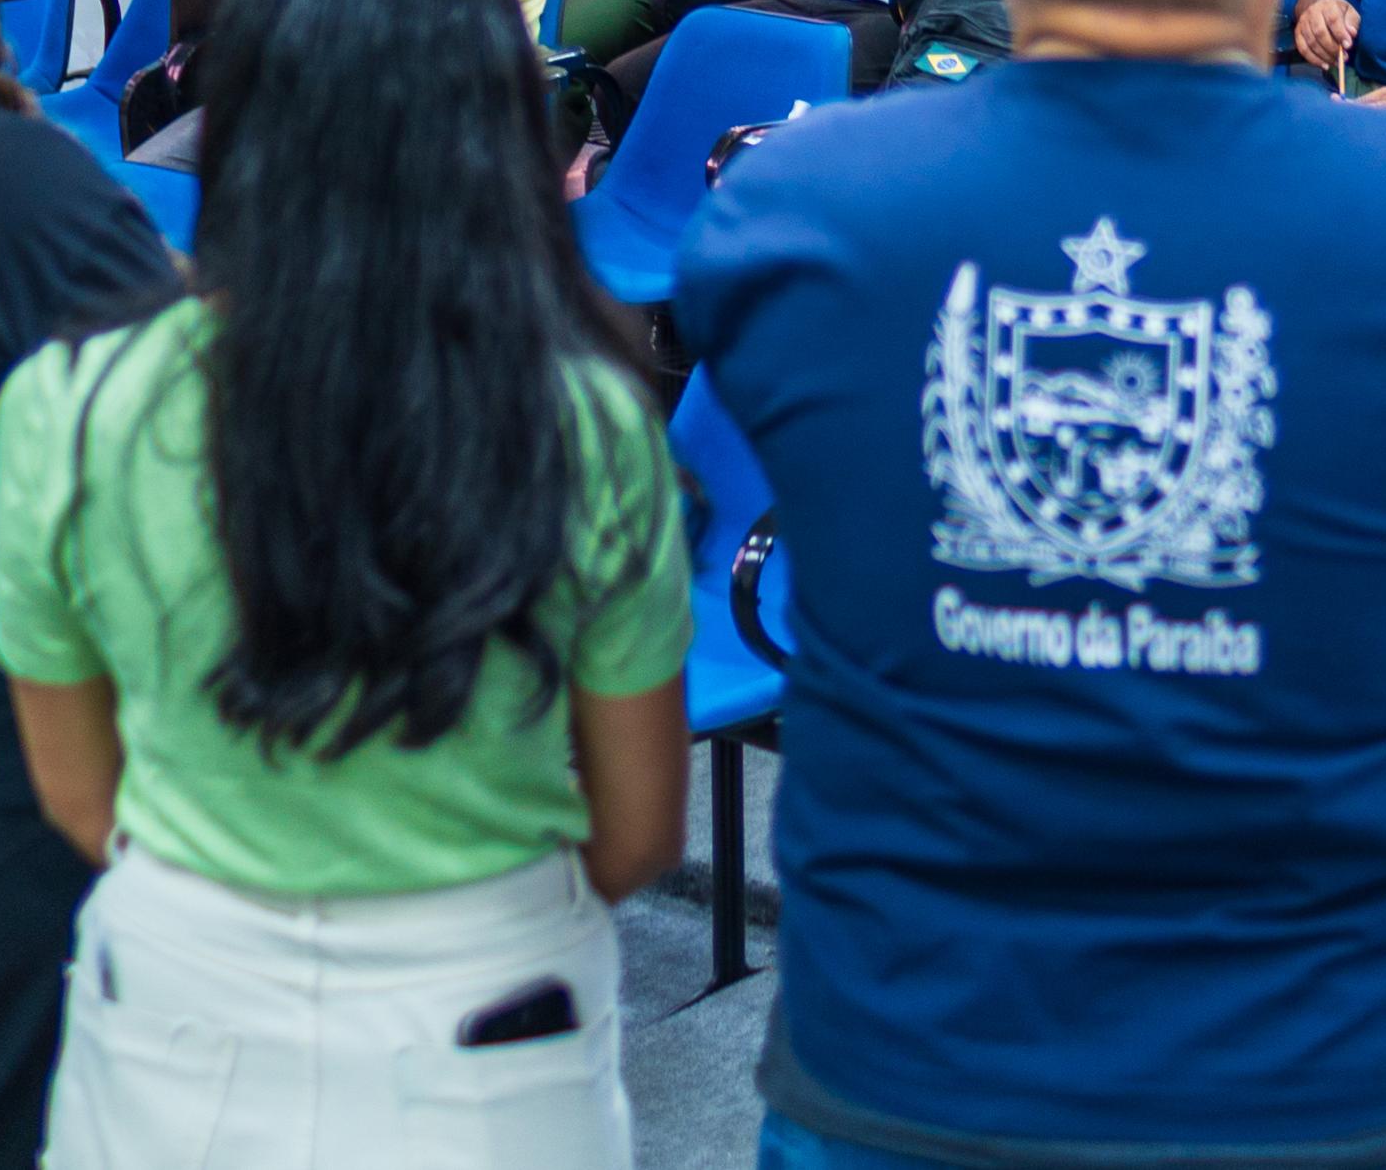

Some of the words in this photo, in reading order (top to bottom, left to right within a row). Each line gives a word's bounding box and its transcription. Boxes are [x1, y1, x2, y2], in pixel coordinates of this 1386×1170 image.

[933, 584, 1073, 668] Governo
[1076, 599, 1124, 670] da
[1126, 600, 1264, 676] Paraíba
